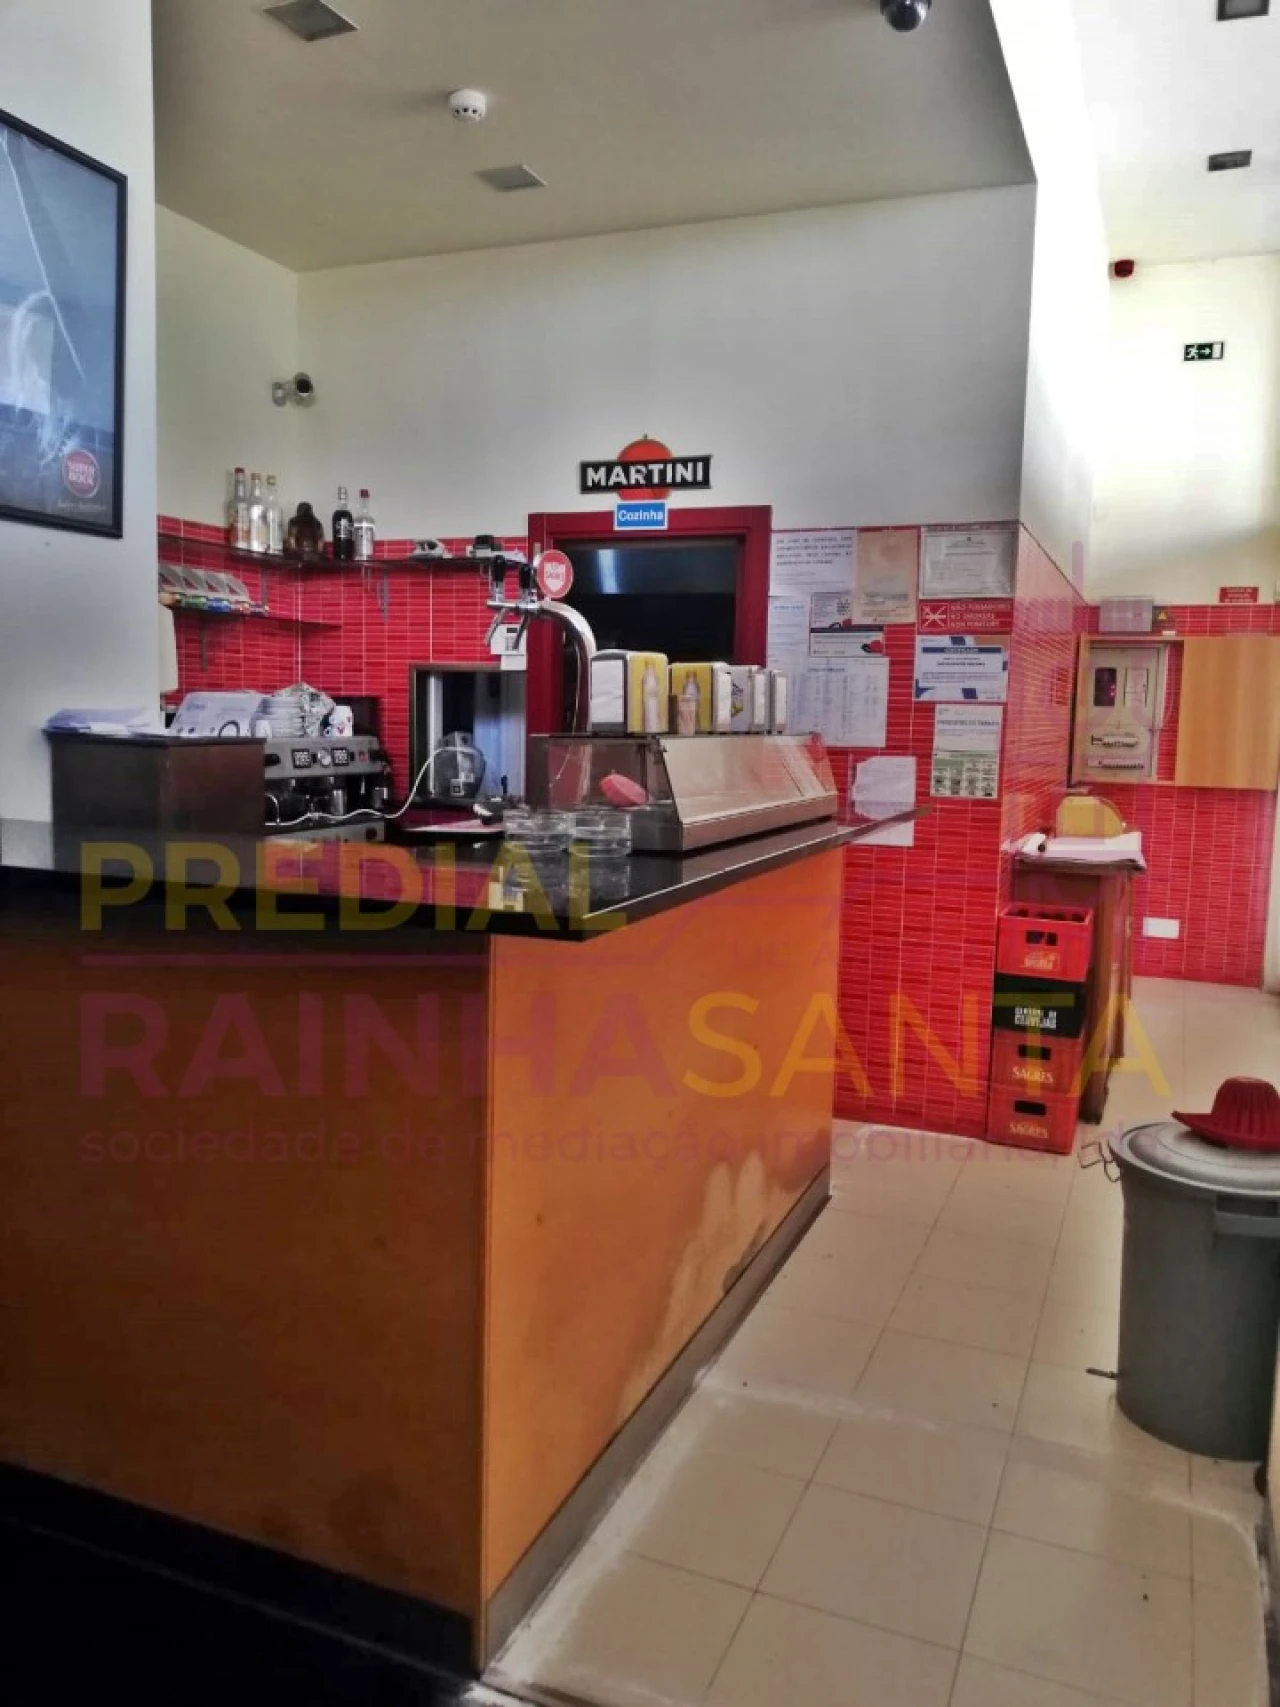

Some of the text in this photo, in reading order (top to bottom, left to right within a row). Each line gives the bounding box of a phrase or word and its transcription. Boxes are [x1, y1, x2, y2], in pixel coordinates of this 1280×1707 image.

[586, 461, 704, 488] MARTINI
[618, 509, 664, 521] Cozinha
[1012, 1066, 1053, 1084] SAGRES
[1009, 1121, 1049, 1139] SAGRES
